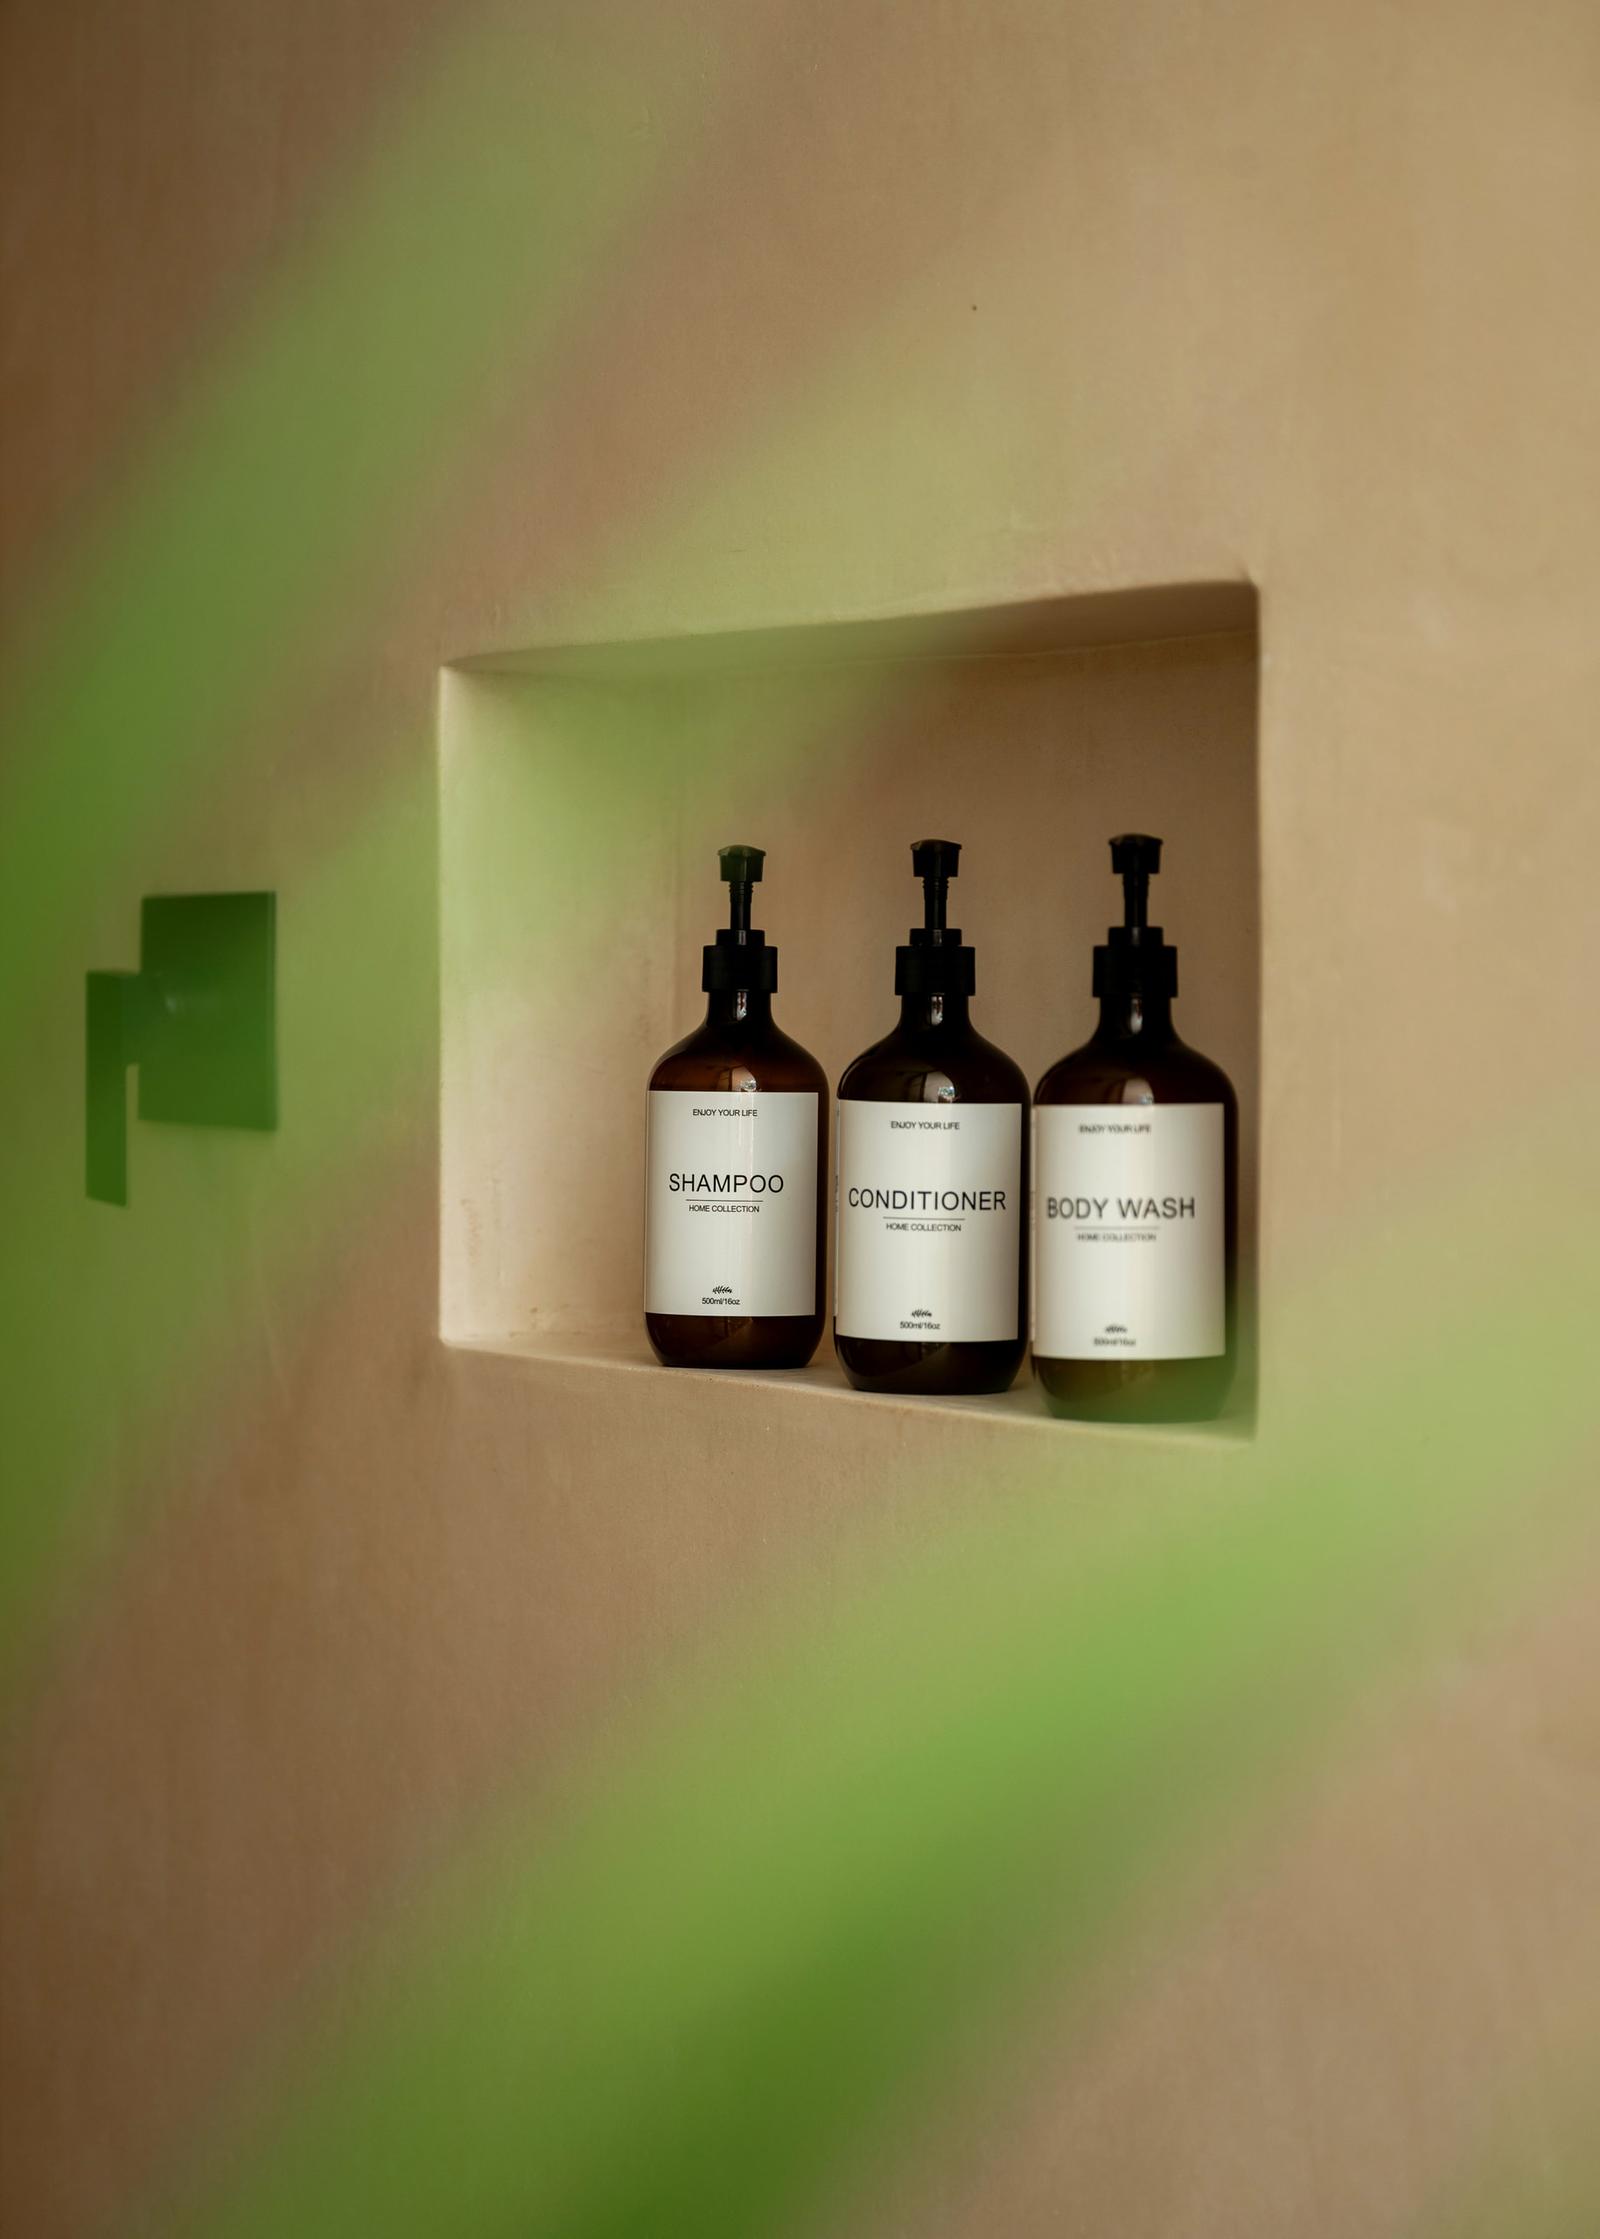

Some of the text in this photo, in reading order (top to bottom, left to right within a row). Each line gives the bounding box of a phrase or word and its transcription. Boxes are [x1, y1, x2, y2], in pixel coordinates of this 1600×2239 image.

[692, 1108, 758, 1117] ENJOY YOUR LIFE
[890, 1120, 960, 1130] ENJOY YOUR LIFE
[668, 1173, 784, 1193] SHAMPOO
[848, 1187, 1006, 1211] CONDITIONER
[688, 1204, 760, 1213] HOME COLLECTION
[1047, 1196, 1196, 1220] BODY WASH
[885, 1222, 962, 1232] HOME COLLECTION
[1077, 1232, 1101, 1242] HOME
[701, 1297, 741, 1305] 500ml/16oz
